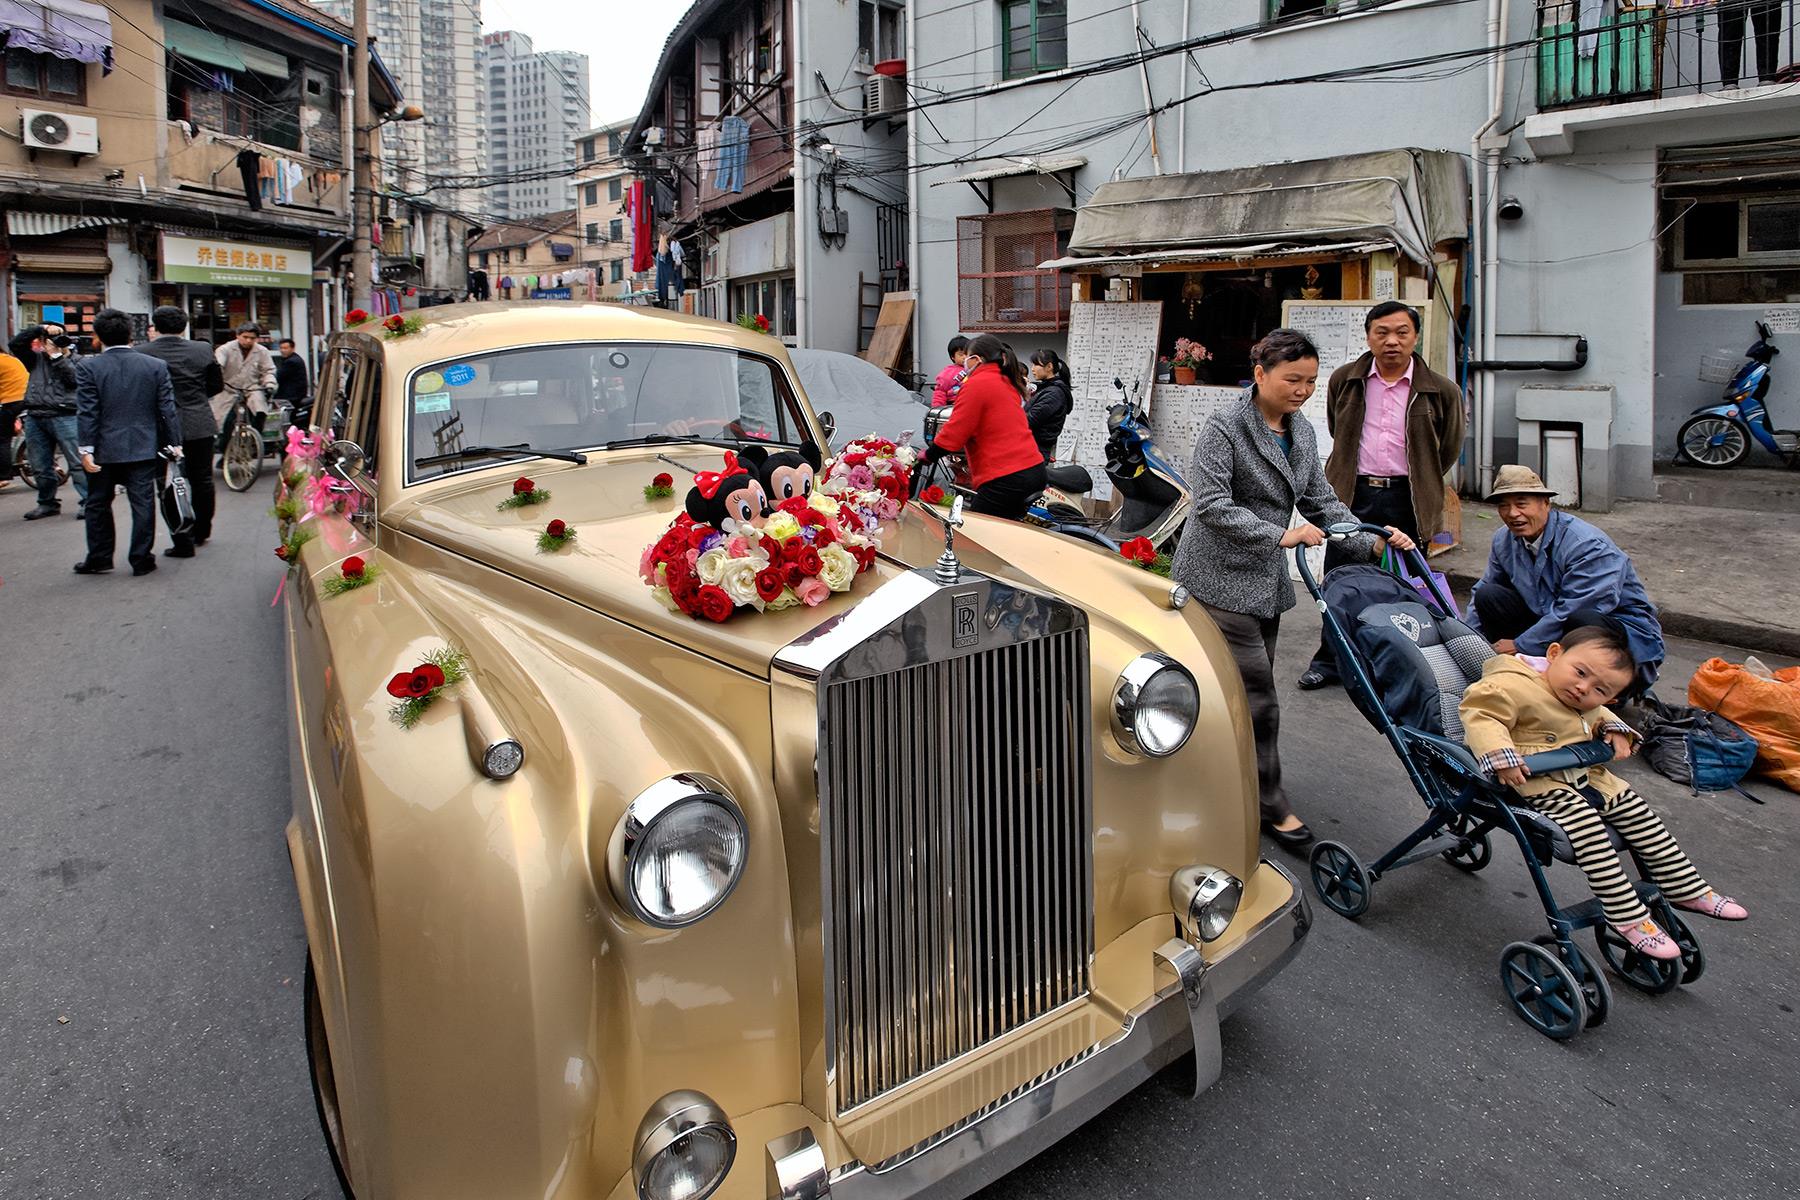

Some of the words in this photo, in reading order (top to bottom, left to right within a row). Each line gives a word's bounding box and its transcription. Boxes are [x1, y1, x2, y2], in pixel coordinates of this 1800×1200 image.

[451, 372, 469, 383] 2011
[956, 596, 977, 605] ROLLS
[956, 638, 977, 646] ROYCE
